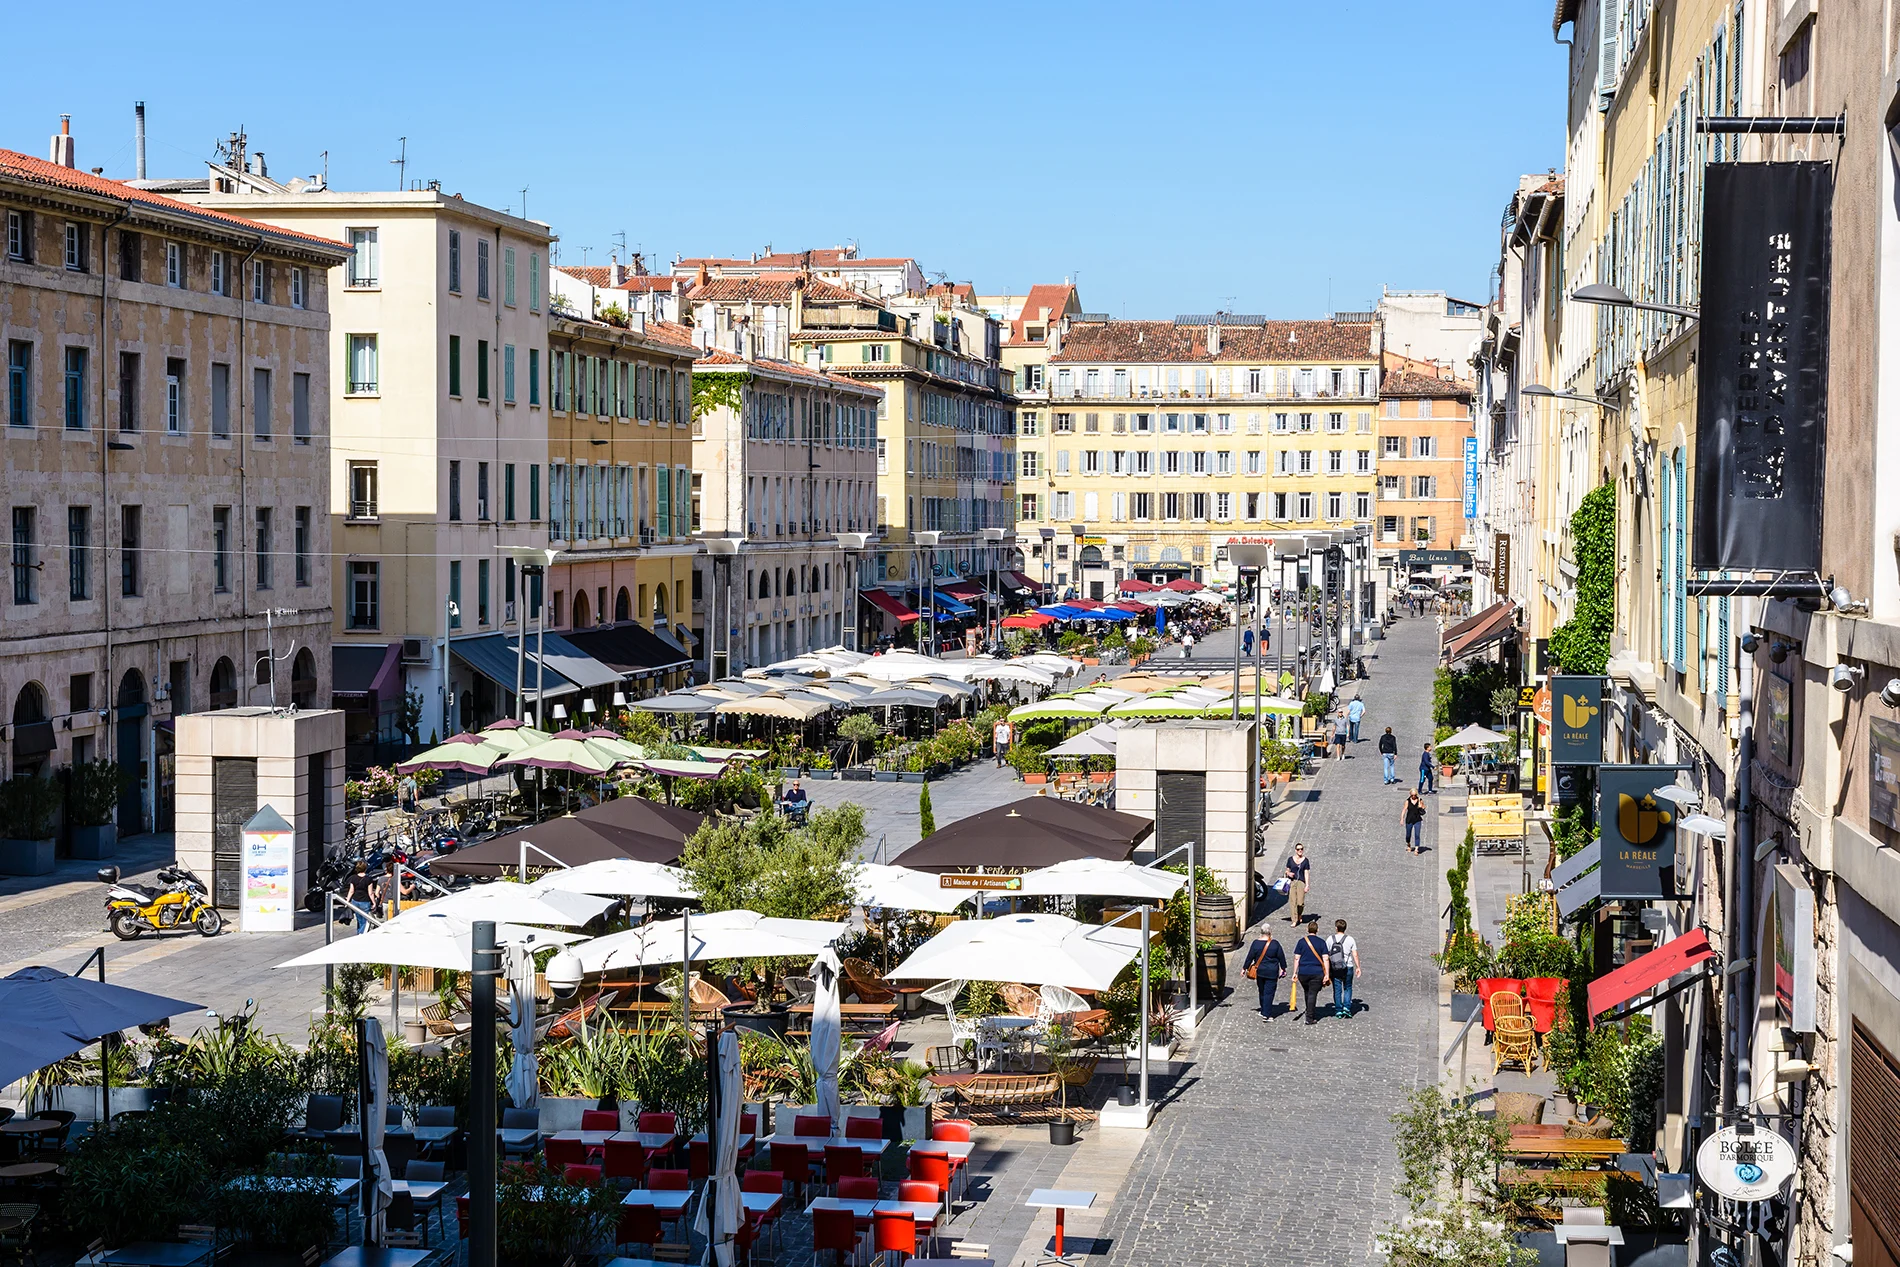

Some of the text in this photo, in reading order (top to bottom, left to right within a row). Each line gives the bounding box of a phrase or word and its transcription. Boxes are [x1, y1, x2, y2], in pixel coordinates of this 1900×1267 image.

[1466, 453, 1477, 515] Marseillaise
[1408, 553, 1424, 561] Bar
[1498, 540, 1507, 590] RESTAURANT
[1619, 849, 1657, 860] LA RÉALE
[952, 878, 971, 886] Maison
[1720, 1140, 1774, 1154] BOLÉE
[1720, 1153, 1774, 1163] D'ARMORIQUE
